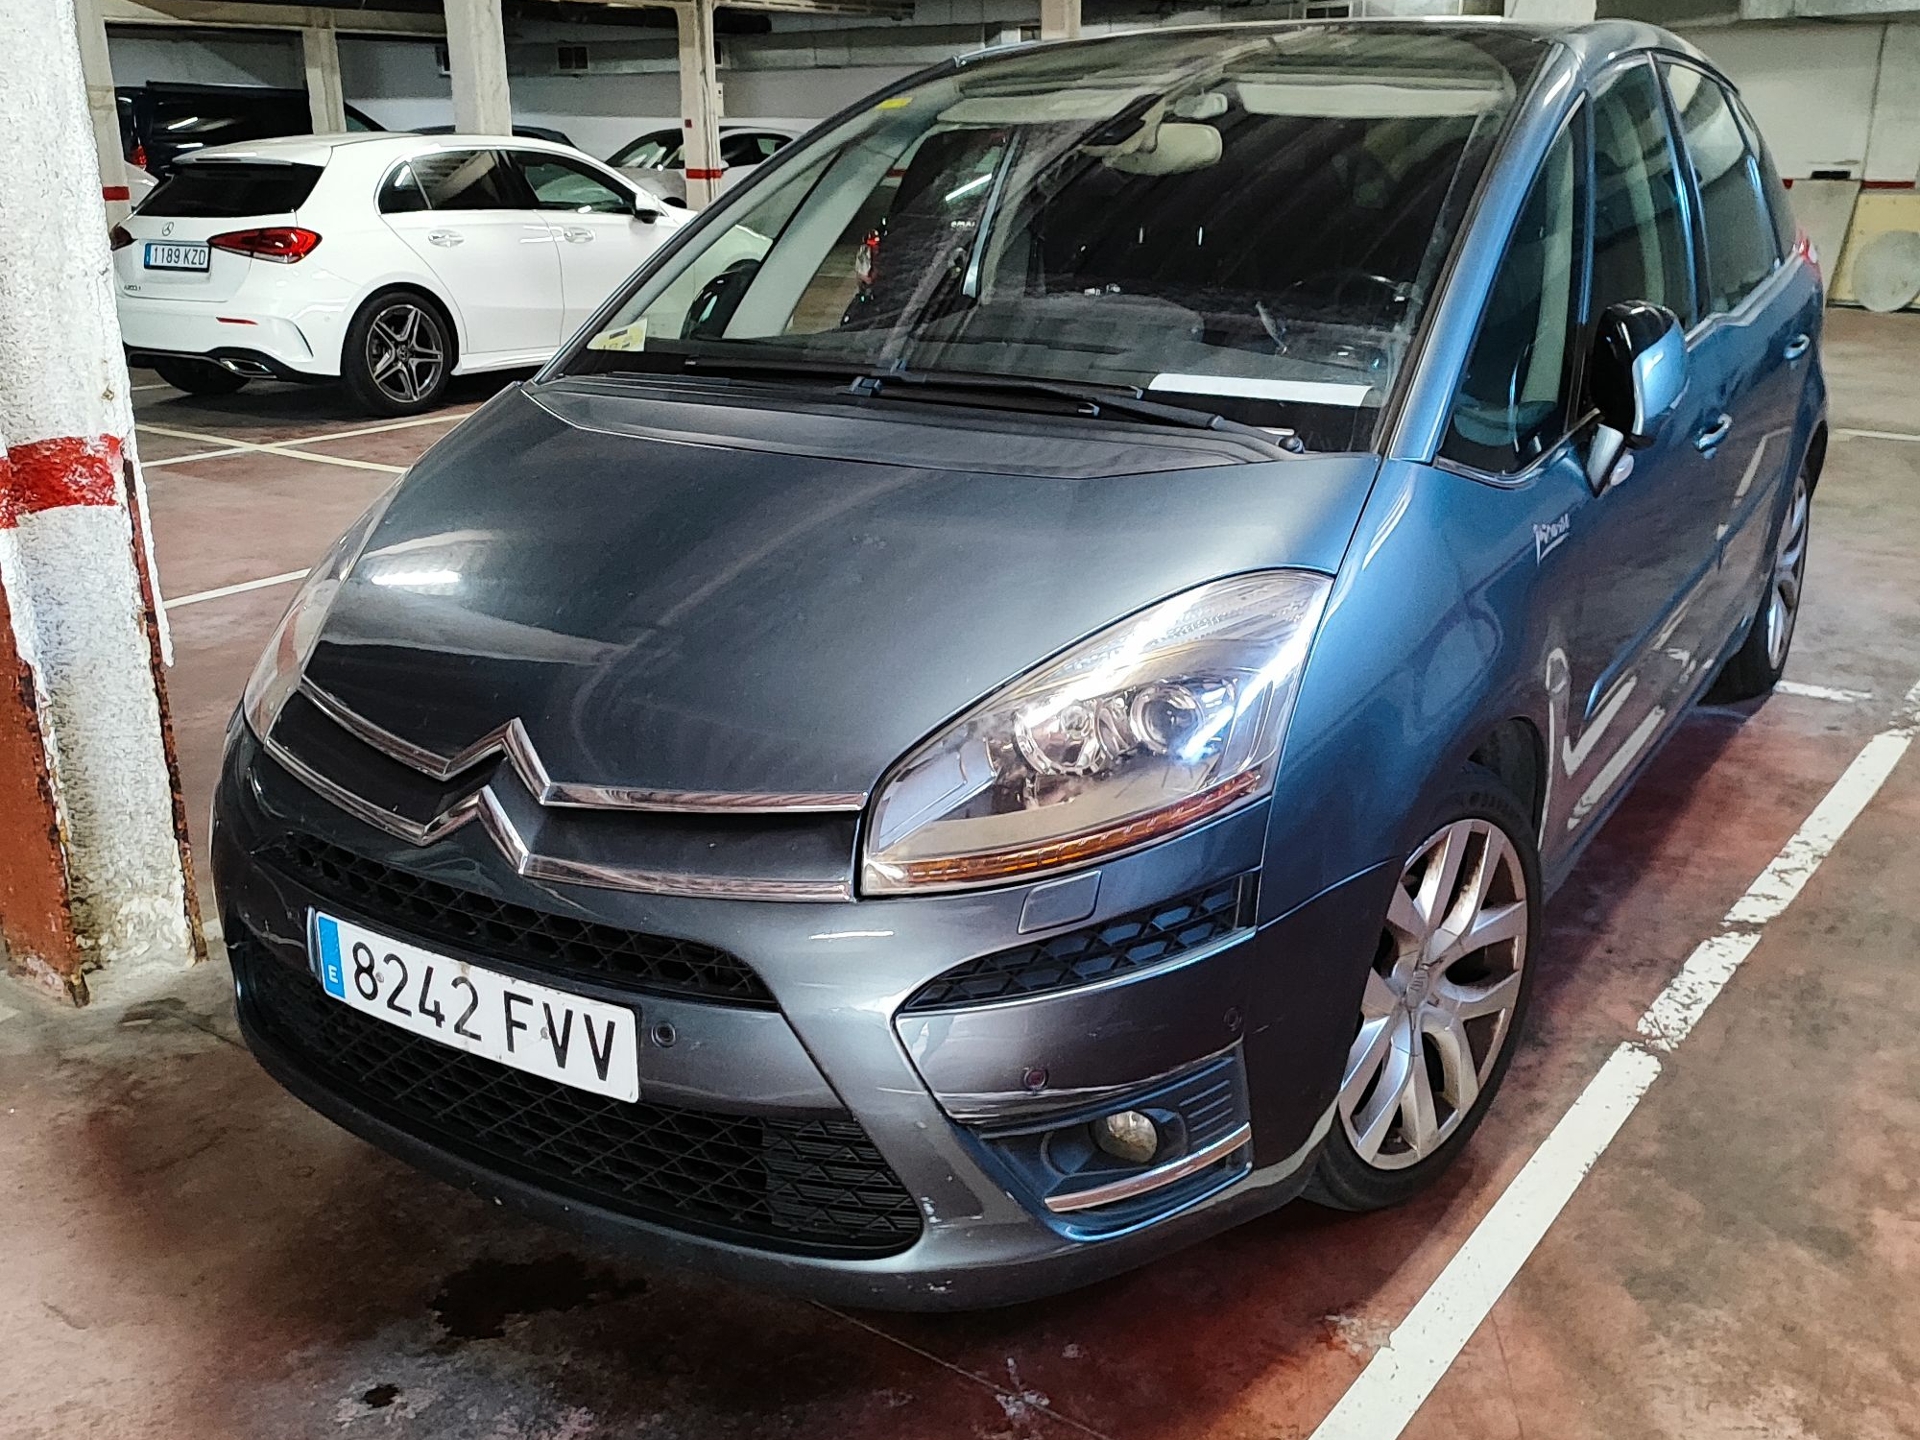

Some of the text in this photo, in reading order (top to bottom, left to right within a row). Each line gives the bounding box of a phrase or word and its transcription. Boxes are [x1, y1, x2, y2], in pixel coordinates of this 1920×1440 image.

[154, 247, 206, 266] 1189 KZD
[327, 964, 339, 984] E
[351, 941, 616, 1082] 8242 FVV
